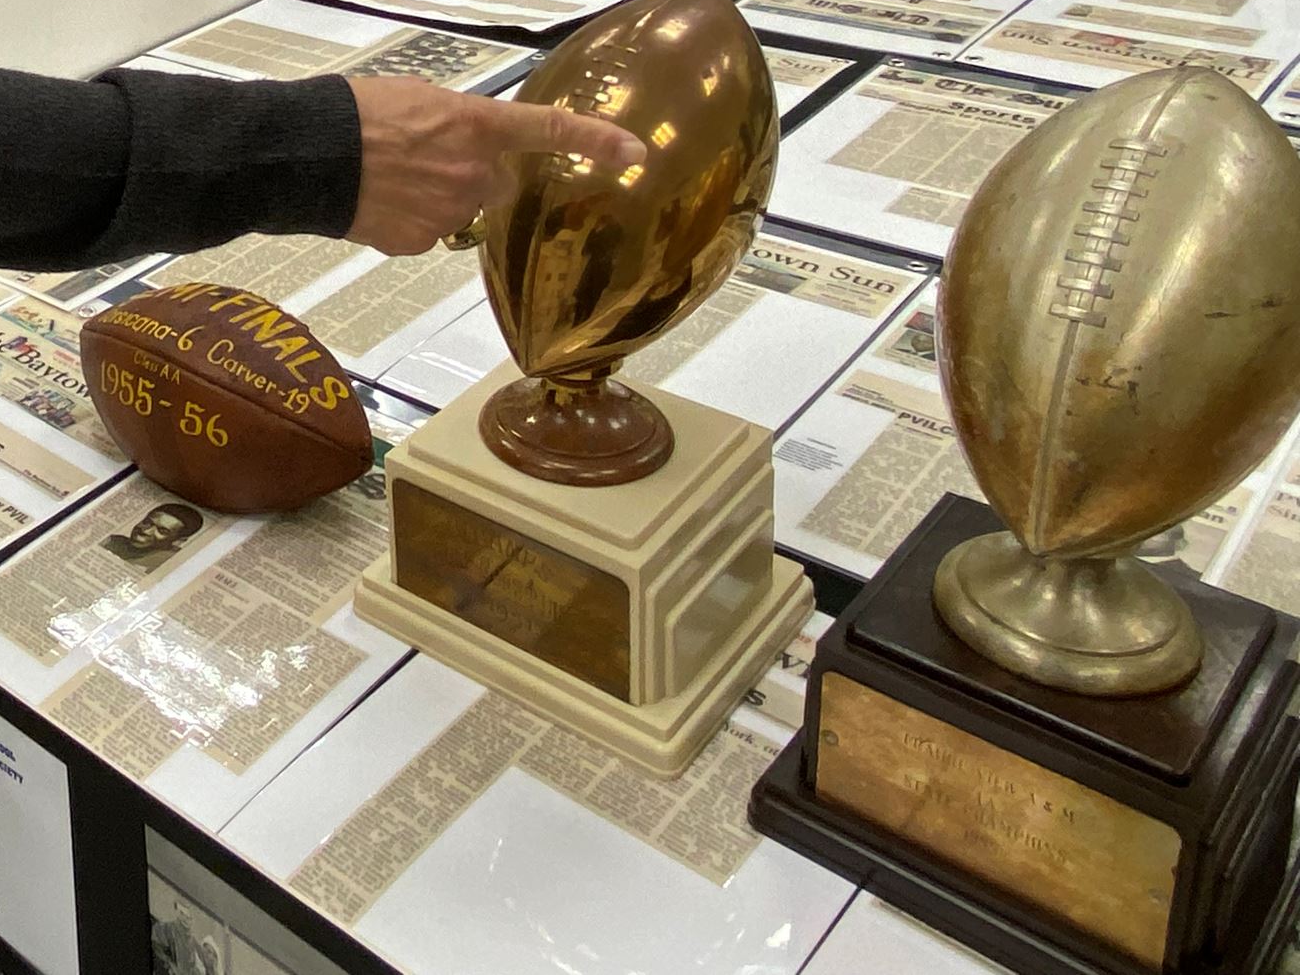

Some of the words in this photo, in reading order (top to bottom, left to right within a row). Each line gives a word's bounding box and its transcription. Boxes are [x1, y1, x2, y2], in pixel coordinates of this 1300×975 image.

[950, 101, 1037, 124] Sports
[1009, 91, 1063, 111] Su
[830, 265, 896, 295] Sun
[12, 346, 91, 398] Baytow
[3, 506, 30, 525] PVIL
